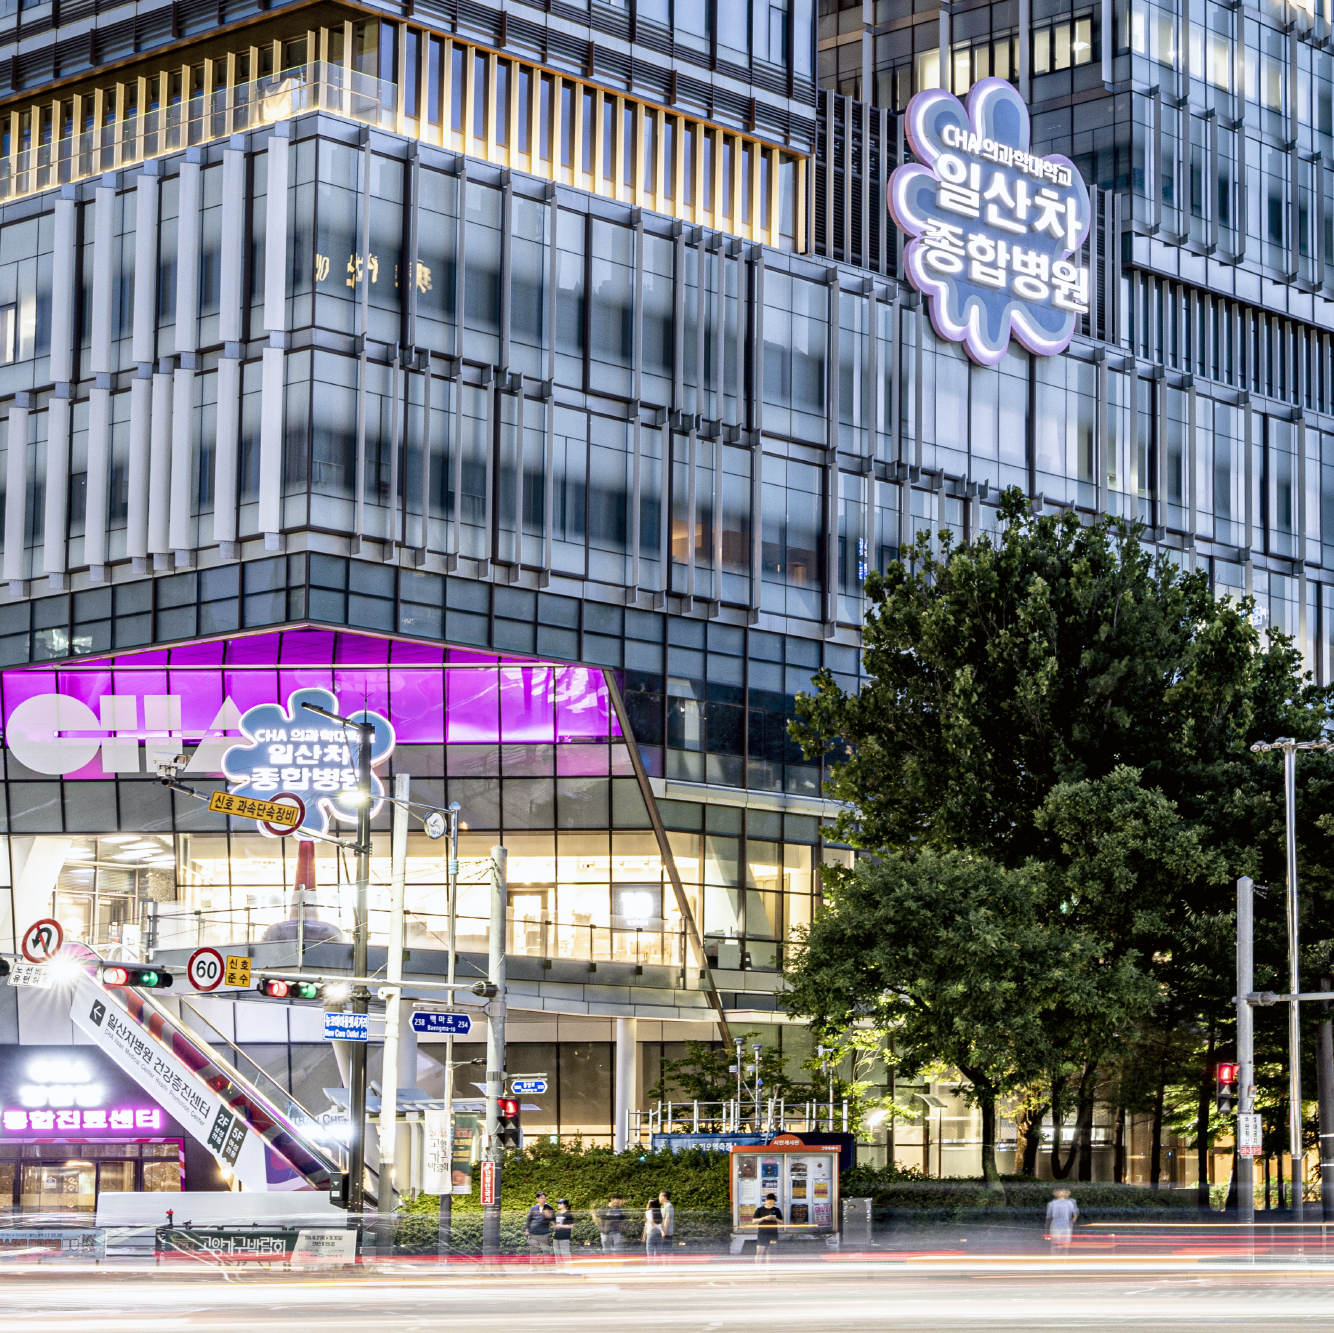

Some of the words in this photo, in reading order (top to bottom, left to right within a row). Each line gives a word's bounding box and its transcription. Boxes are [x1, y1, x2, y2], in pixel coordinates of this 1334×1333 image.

[942, 124, 979, 154] CHA
[934, 153, 1082, 251] 일산차
[922, 218, 1089, 313] 종합병원
[255, 729, 287, 742] CHA
[268, 744, 352, 765] 일산차
[251, 767, 360, 791] 종합병원
[215, 795, 234, 810] 신호
[237, 800, 295, 823] 과속단속장비
[196, 960, 217, 979] 60
[229, 958, 249, 970] 신호
[228, 971, 249, 984] 준수
[414, 1018, 425, 1026] 238
[430, 1015, 454, 1025] 백마로
[154, 1057, 211, 1119] 건강증진센터
[217, 1113, 230, 1127] 2F
[232, 1127, 244, 1141] 5F
[198, 1236, 286, 1257] 고양가구박람회
